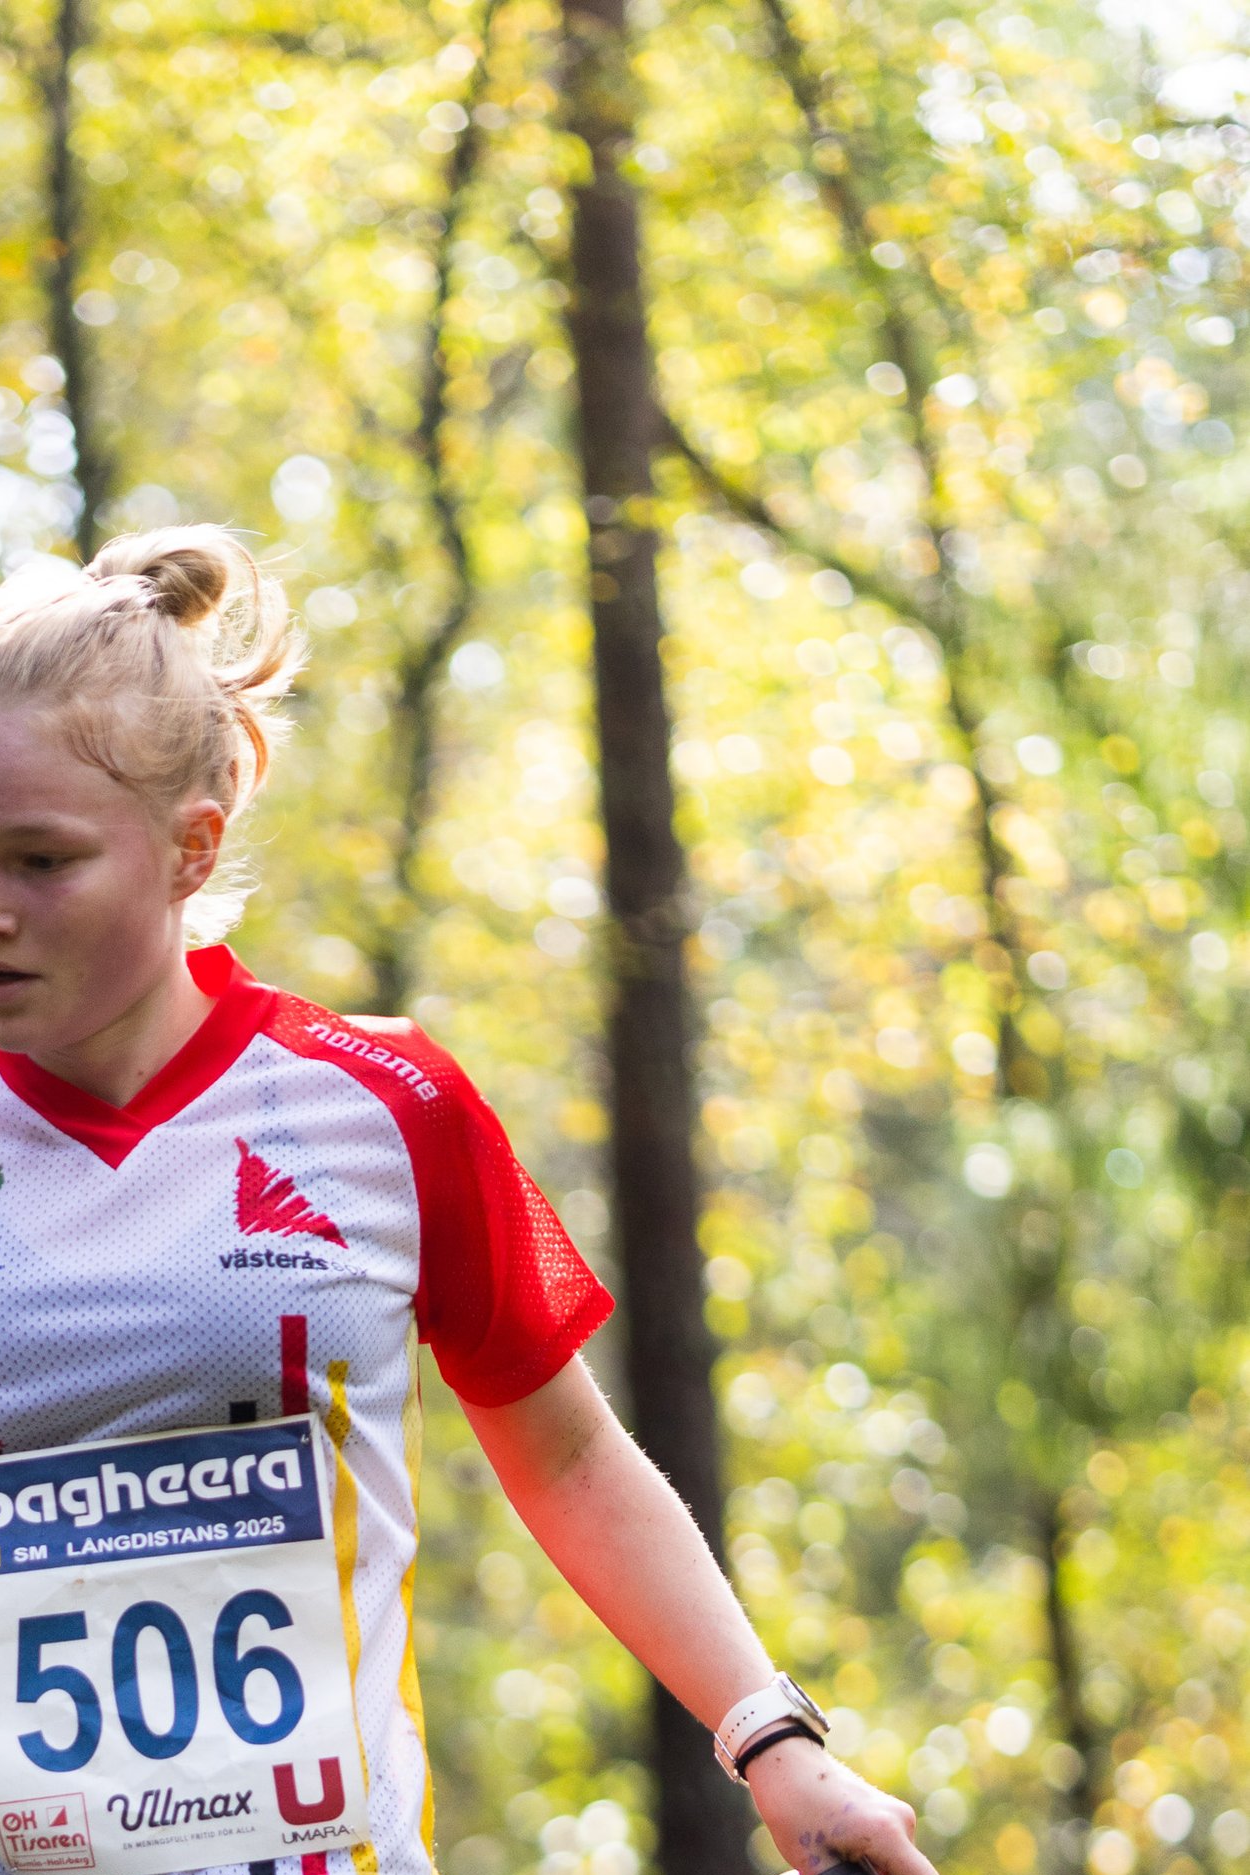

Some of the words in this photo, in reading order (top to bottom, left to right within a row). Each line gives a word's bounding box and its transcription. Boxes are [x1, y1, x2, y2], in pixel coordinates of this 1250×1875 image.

[303, 1021, 439, 1102] noname
[218, 1248, 329, 1270] västerås
[13, 1544, 48, 1563] SM
[233, 1515, 286, 1539] 2025
[15, 1588, 306, 1773] 506
[106, 1786, 253, 1832] Ullmax
[272, 1756, 346, 1826] U
[6, 1833, 86, 1852] Tisaren
[190, 1831, 216, 1842] FRITID
[217, 1827, 234, 1838] FÖR
[235, 1825, 257, 1835] ALLA
[281, 1824, 351, 1845] UMARA
